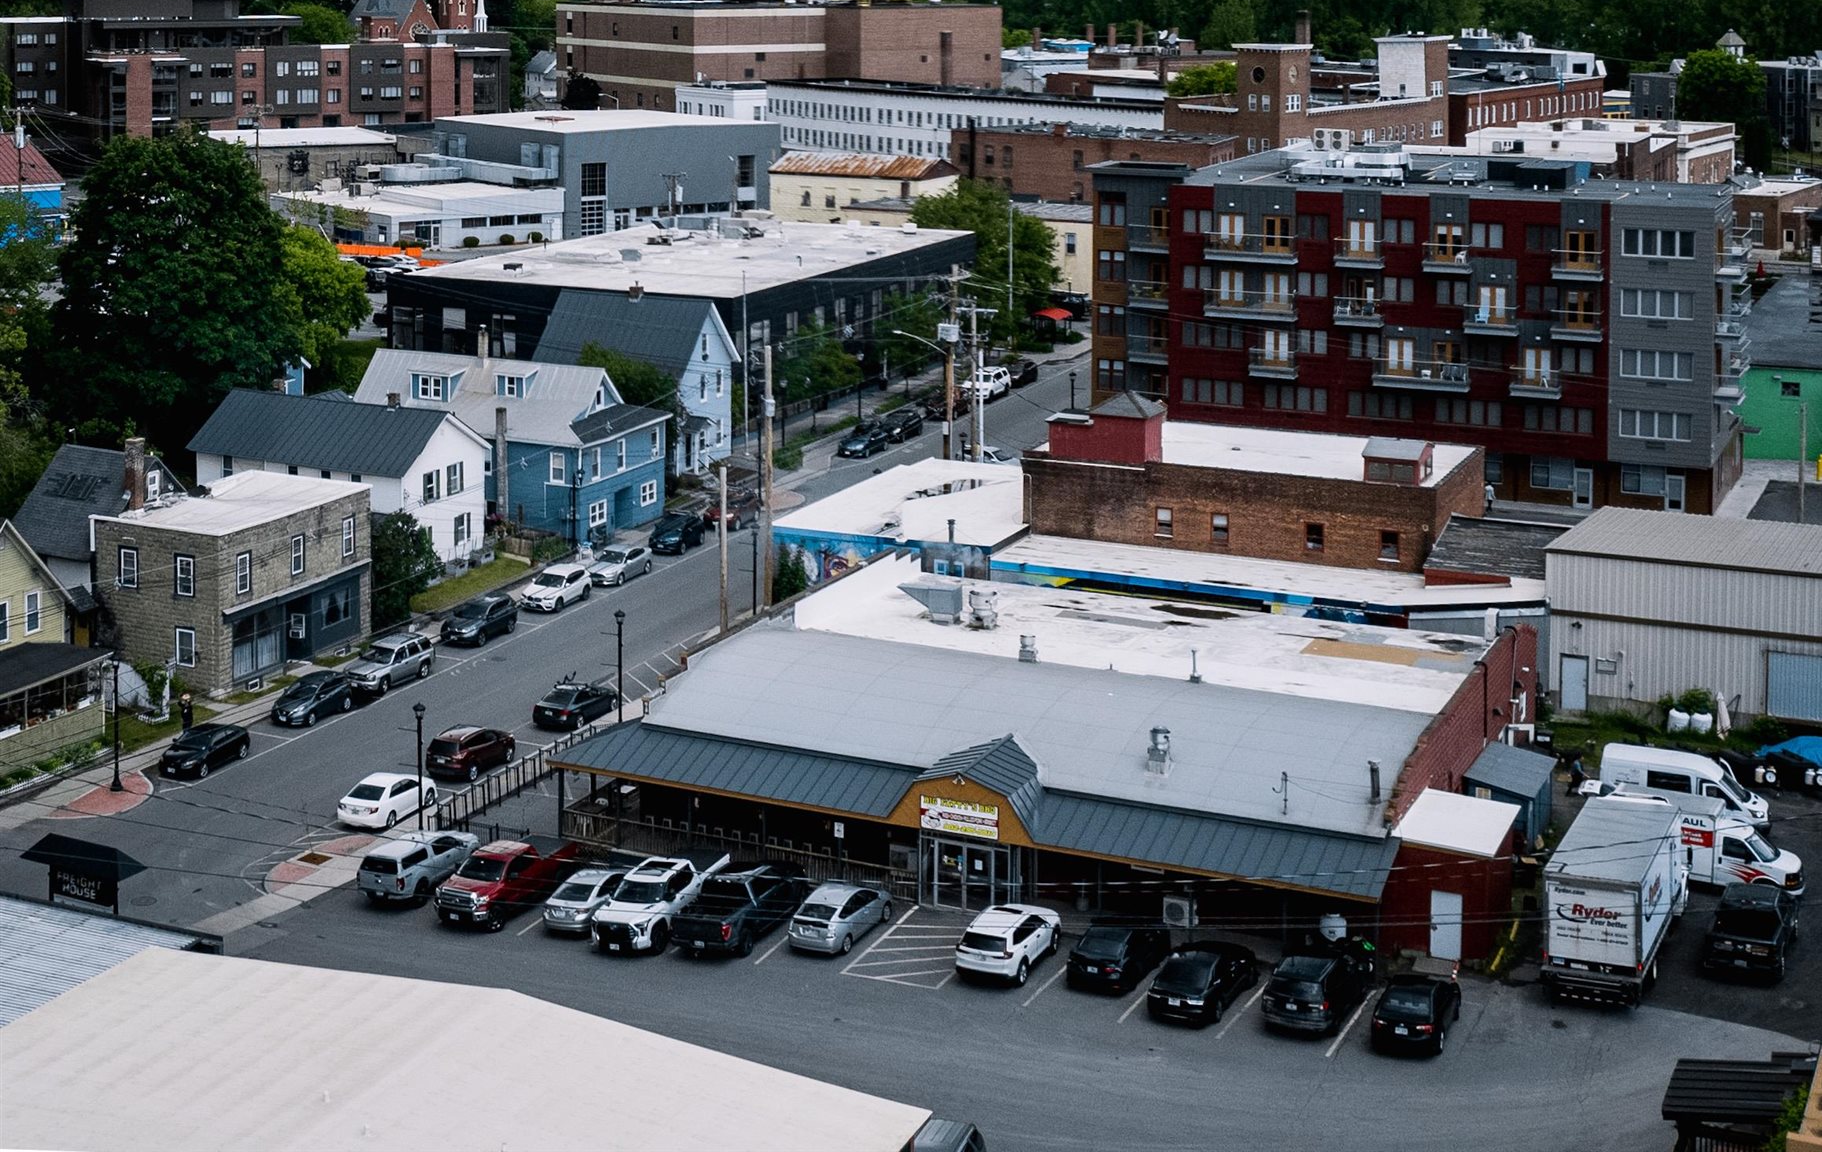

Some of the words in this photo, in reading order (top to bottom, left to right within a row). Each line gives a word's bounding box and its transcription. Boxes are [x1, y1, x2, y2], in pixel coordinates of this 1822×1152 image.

[57, 871, 102, 890] FREIGHT
[62, 883, 96, 899] HOUSE
[1555, 887, 1586, 895] Ryder.com
[1571, 903, 1622, 920] Ryder
[1590, 917, 1606, 926] Ever
